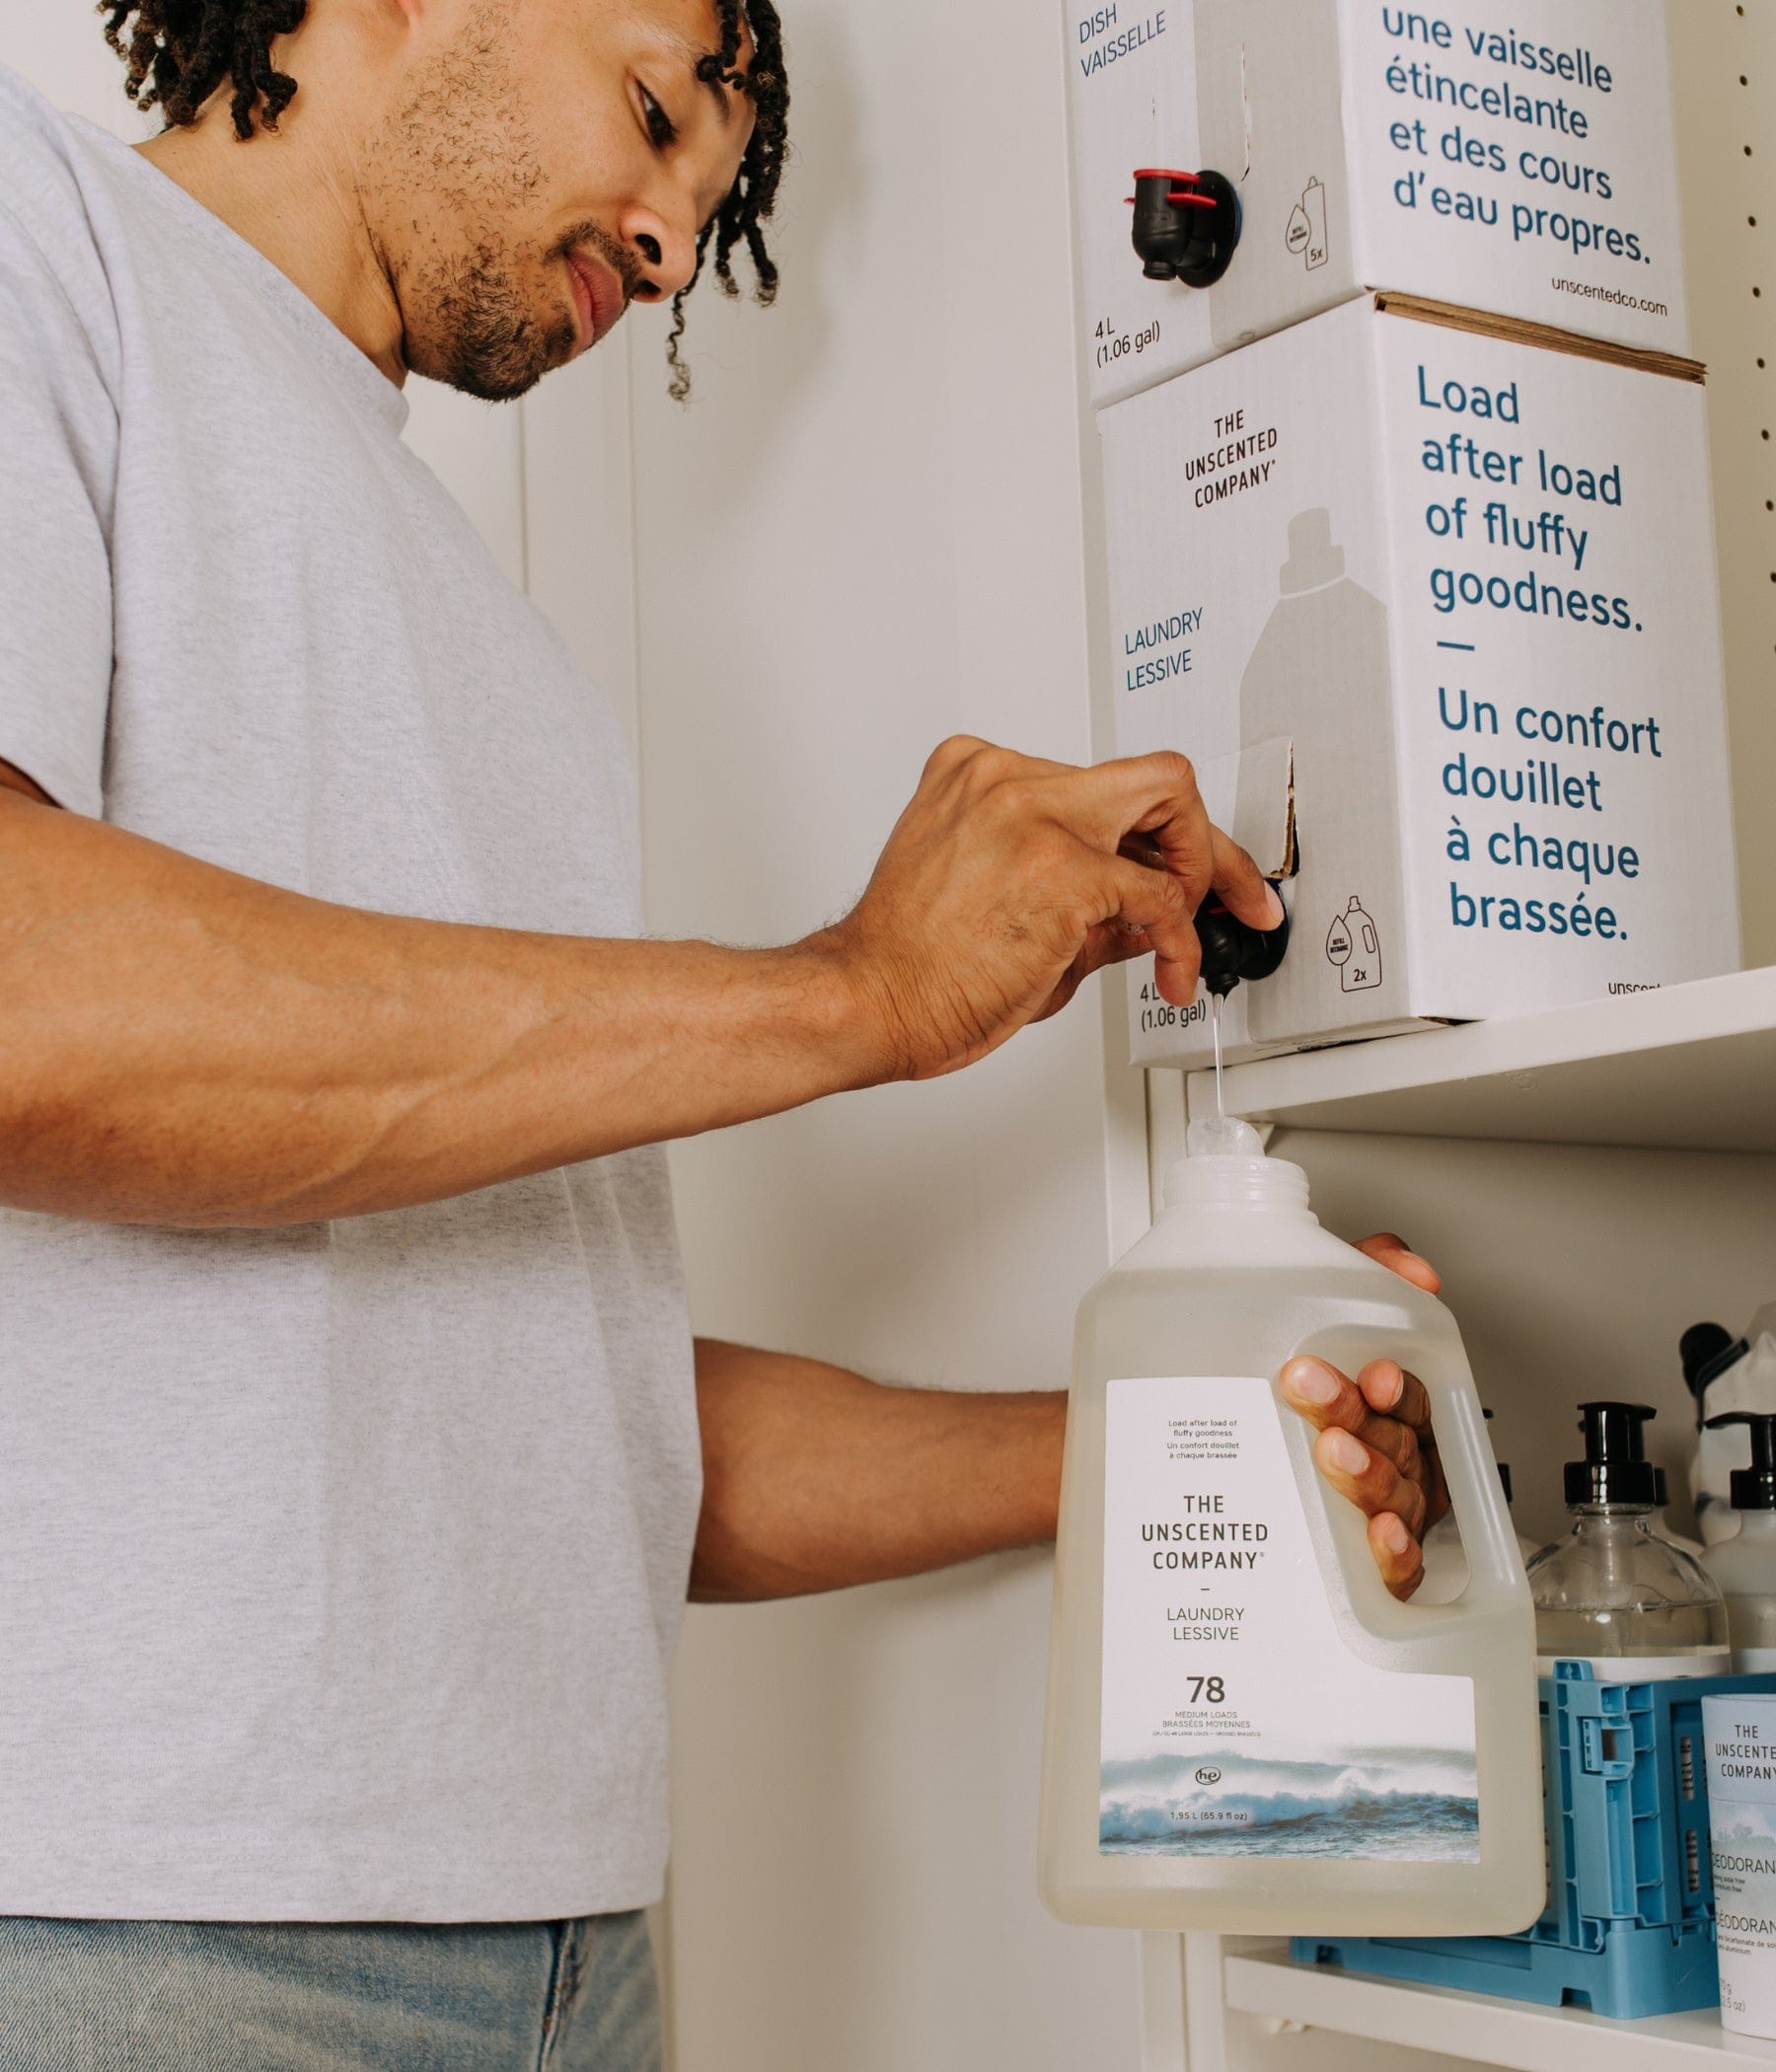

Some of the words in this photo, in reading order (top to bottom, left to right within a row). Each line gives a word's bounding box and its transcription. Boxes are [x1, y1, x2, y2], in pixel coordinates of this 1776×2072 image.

[1079, 3, 1117, 44] DISH
[1080, 10, 1166, 77] VAISSELLE
[1382, 7, 1452, 48] une
[1465, 29, 1612, 93] vaisselle
[1385, 54, 1589, 138] étincelante
[1389, 119, 1427, 156] et
[1441, 125, 1507, 173] des
[1519, 151, 1612, 199] cours
[1393, 171, 1498, 226] d'eau
[1513, 203, 1651, 263] propres.
[1551, 277, 1667, 316] unscentedco.com
[1095, 321, 1103, 338] 4
[1107, 317, 1115, 334] L
[1097, 334, 1131, 368] (1.06
[1135, 320, 1160, 353] gal)
[1418, 365, 1519, 424] Load
[1214, 409, 1243, 438] THE
[1185, 428, 1278, 481] UNSCENTED
[1422, 433, 1522, 484] after
[1538, 449, 1621, 506] load
[1426, 497, 1467, 539] of
[1483, 502, 1588, 570] fluffy
[1431, 568, 1642, 631] goodness.
[1125, 607, 1203, 655] LAUNDRY
[1127, 649, 1192, 691] LESSIVE
[1439, 687, 1499, 734] Un
[1516, 706, 1662, 758] confort
[1443, 752, 1602, 812] douillet
[1446, 814, 1470, 861] à
[1488, 823, 1639, 885] chaque
[1450, 881, 1627, 940] brassée.
[1141, 983, 1148, 1002] 4
[1152, 982, 1160, 1000] L
[1354, 968, 1367, 982] 2x
[1142, 1005, 1176, 1033] (1.06
[1180, 999, 1206, 1027] gal)
[1176, 1451, 1205, 1460] chaque
[1183, 1495, 1224, 1513] THE
[1142, 1523, 1268, 1541] UNSCENTED
[1166, 1607, 1245, 1621] LAUNDRY
[1173, 1626, 1239, 1641] LESSIVE
[1186, 1676, 1226, 1704] 78
[1162, 1718, 1204, 1728] BRASSÉES
[1174, 1710, 1209, 1719] MEDIUM
[1210, 1710, 1238, 1719] LOADS
[1735, 1724, 1758, 1739] THE
